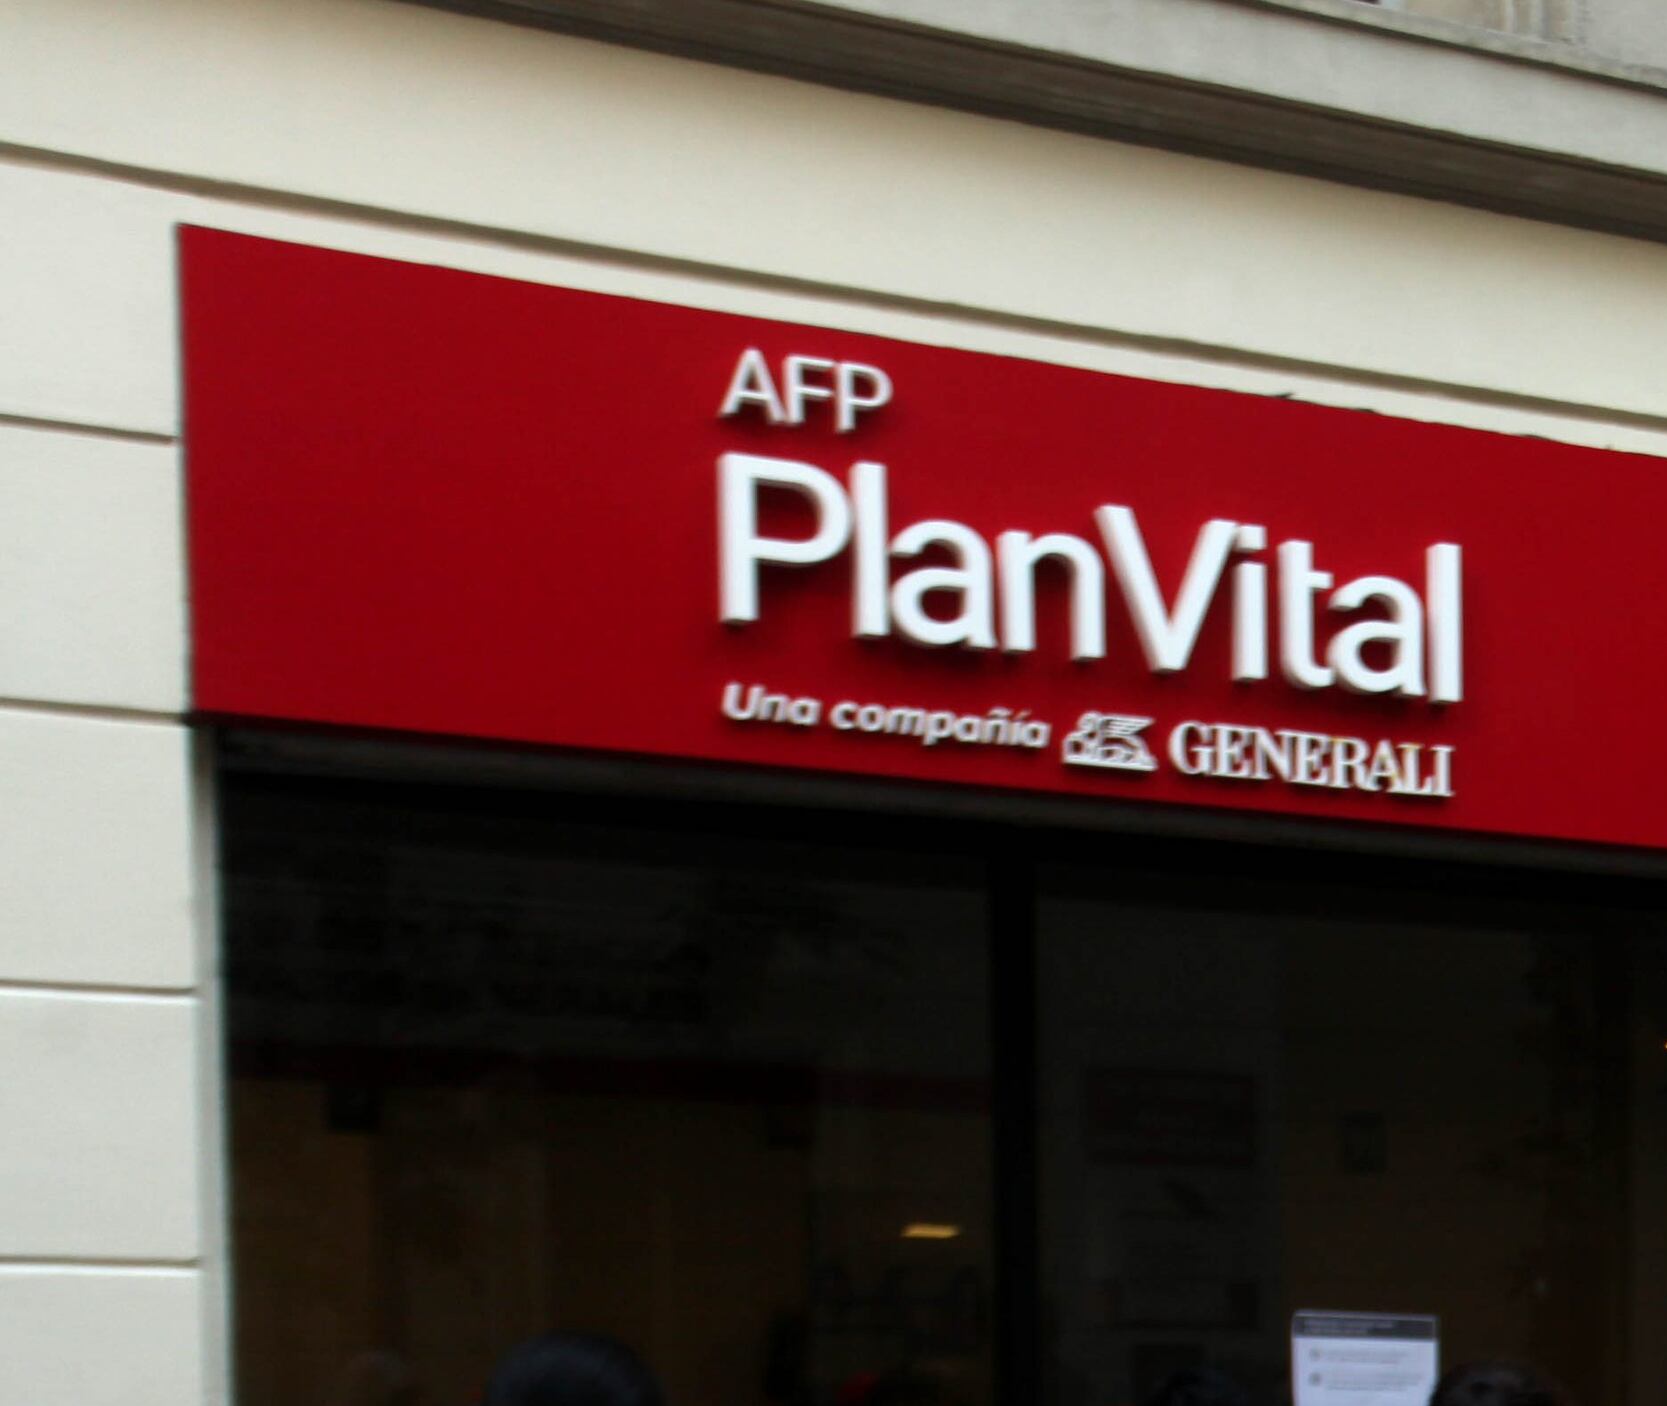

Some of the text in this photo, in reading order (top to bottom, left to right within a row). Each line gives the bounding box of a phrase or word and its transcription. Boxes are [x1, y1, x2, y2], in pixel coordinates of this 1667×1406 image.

[719, 348, 893, 432] AFP
[717, 450, 1464, 705] PlanVital
[722, 681, 1455, 797] Una compañía GENERALI
